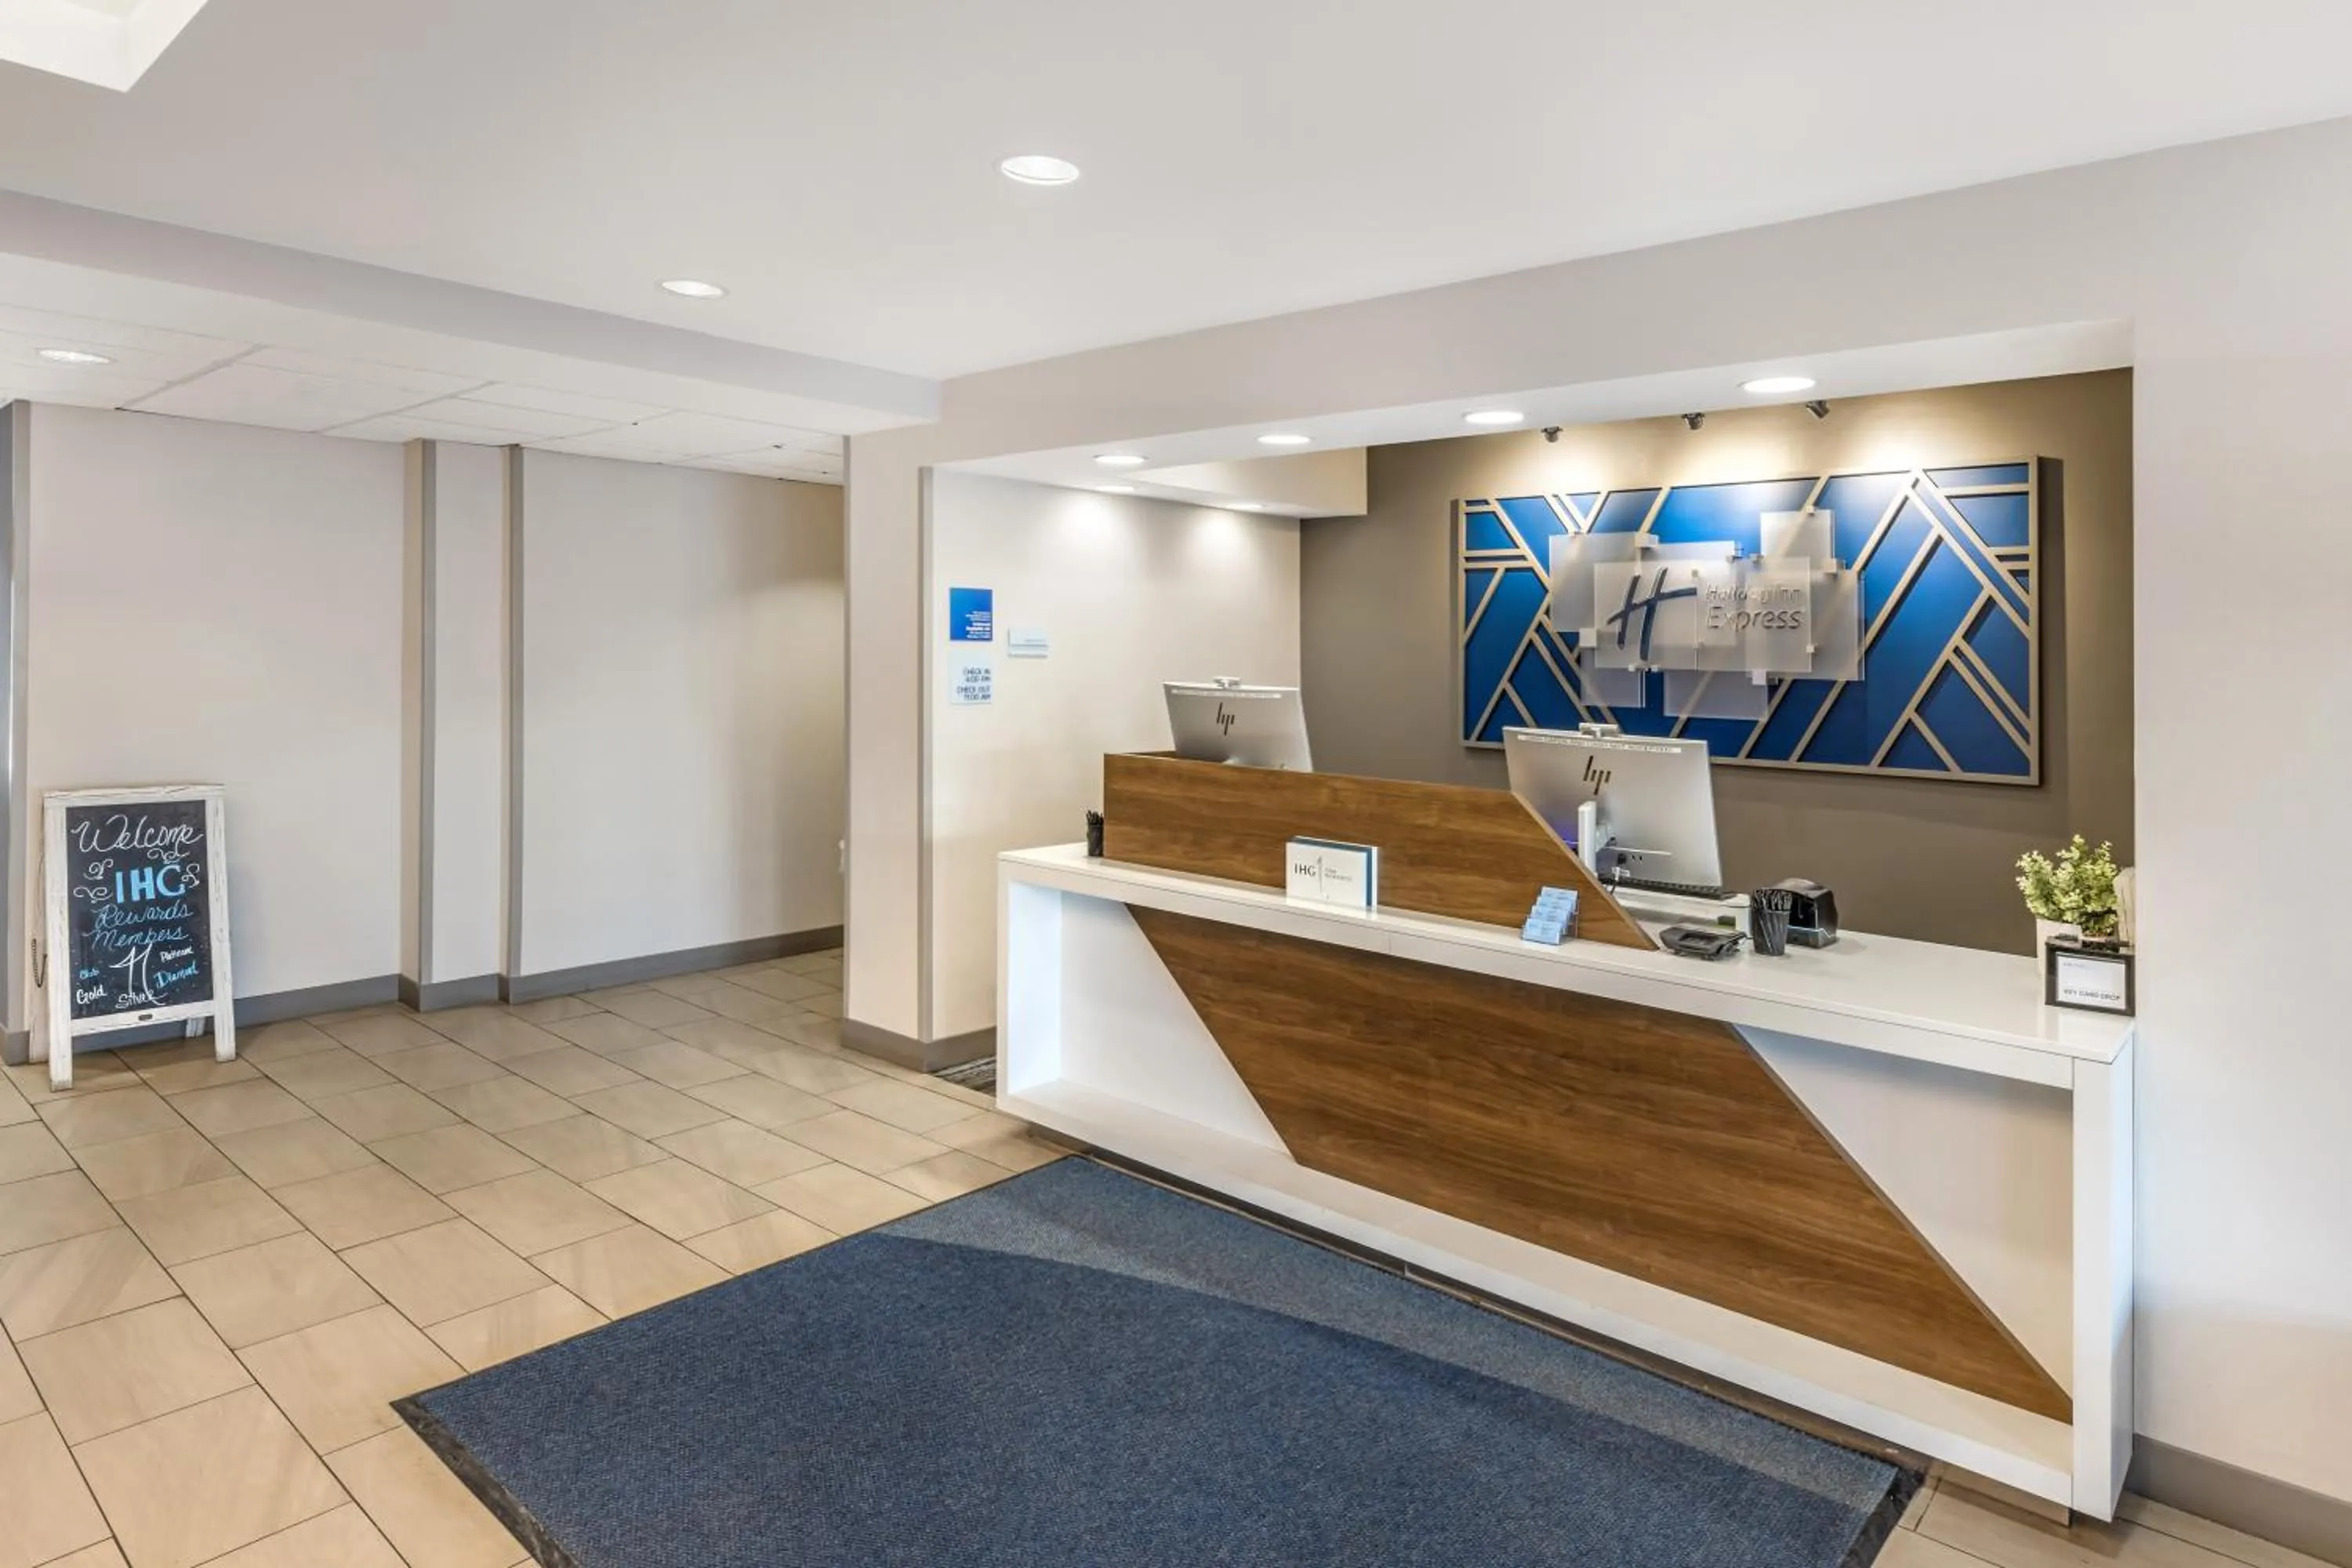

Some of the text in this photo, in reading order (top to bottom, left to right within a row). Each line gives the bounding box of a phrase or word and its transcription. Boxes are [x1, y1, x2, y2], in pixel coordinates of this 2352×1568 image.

[1707, 604, 1803, 632] Express
[1216, 702, 1235, 735] hp
[1583, 755, 1611, 795] hp
[71, 814, 204, 855] Welcome
[1294, 863, 1316, 877] IHG
[90, 900, 194, 928] Rewards
[82, 926, 189, 951] Members
[76, 984, 107, 1004] Gold
